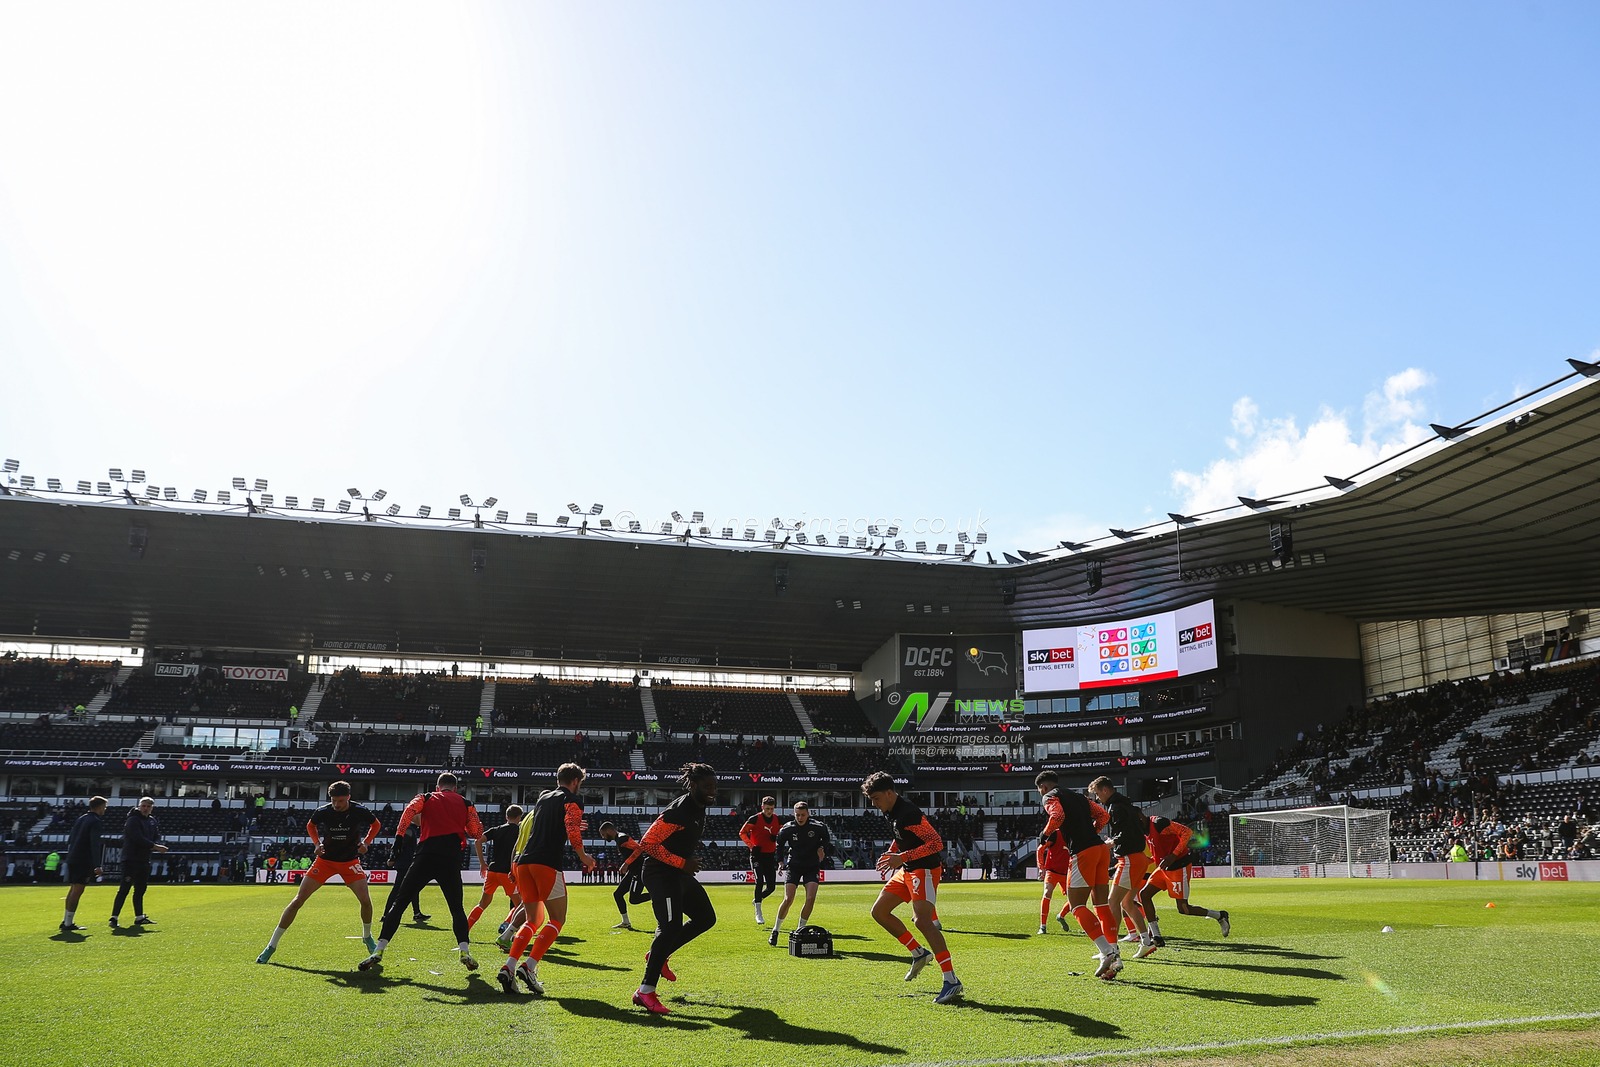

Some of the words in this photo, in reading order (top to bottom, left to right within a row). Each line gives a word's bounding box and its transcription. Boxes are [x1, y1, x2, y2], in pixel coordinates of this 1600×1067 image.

[1180, 630, 1194, 643] sky
[1196, 626, 1211, 637] bet
[1198, 640, 1213, 648] BETTER
[905, 647, 954, 666] DCFC
[1030, 650, 1048, 662] sky
[1052, 648, 1072, 659] bet
[158, 666, 183, 674] RAMS
[223, 667, 287, 680] TOYOTA
[370, 871, 386, 880] bet
[732, 872, 746, 880] sky
[1516, 864, 1537, 880] sky
[1542, 864, 1565, 878] bet
[913, 877, 920, 888] 9
